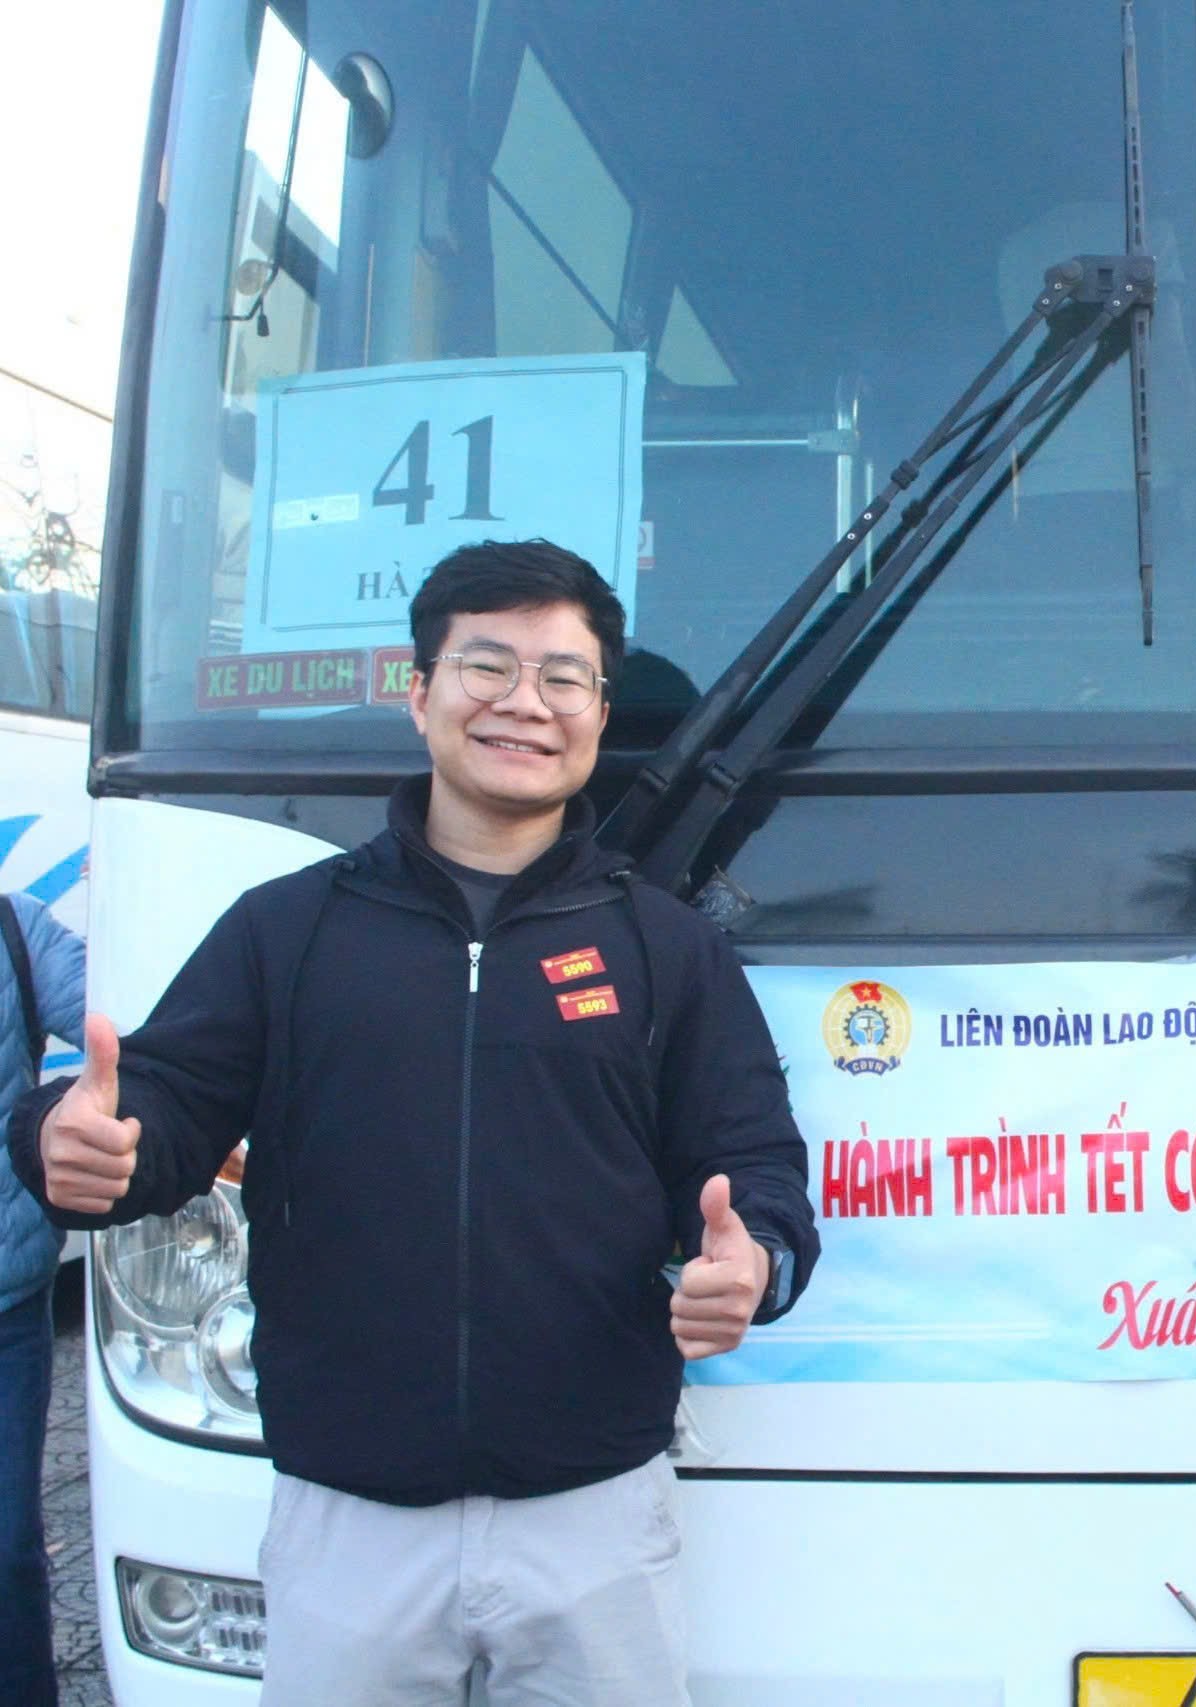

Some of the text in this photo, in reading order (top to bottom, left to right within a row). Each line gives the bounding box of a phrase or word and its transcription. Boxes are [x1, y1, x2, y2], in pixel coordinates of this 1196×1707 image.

[372, 414, 505, 525] 41
[357, 560, 409, 601] HÀ
[207, 665, 239, 697] XE
[247, 661, 284, 694] DU
[577, 998, 608, 1015] 5593
[940, 1007, 1003, 1047] LIÊN
[1012, 1009, 1093, 1047] ĐOÀN
[1103, 1012, 1154, 1045] LAO
[822, 1121, 933, 1218] HÀNH
[946, 1116, 1066, 1216] TRÌNH
[1081, 1102, 1150, 1213] TẾT
